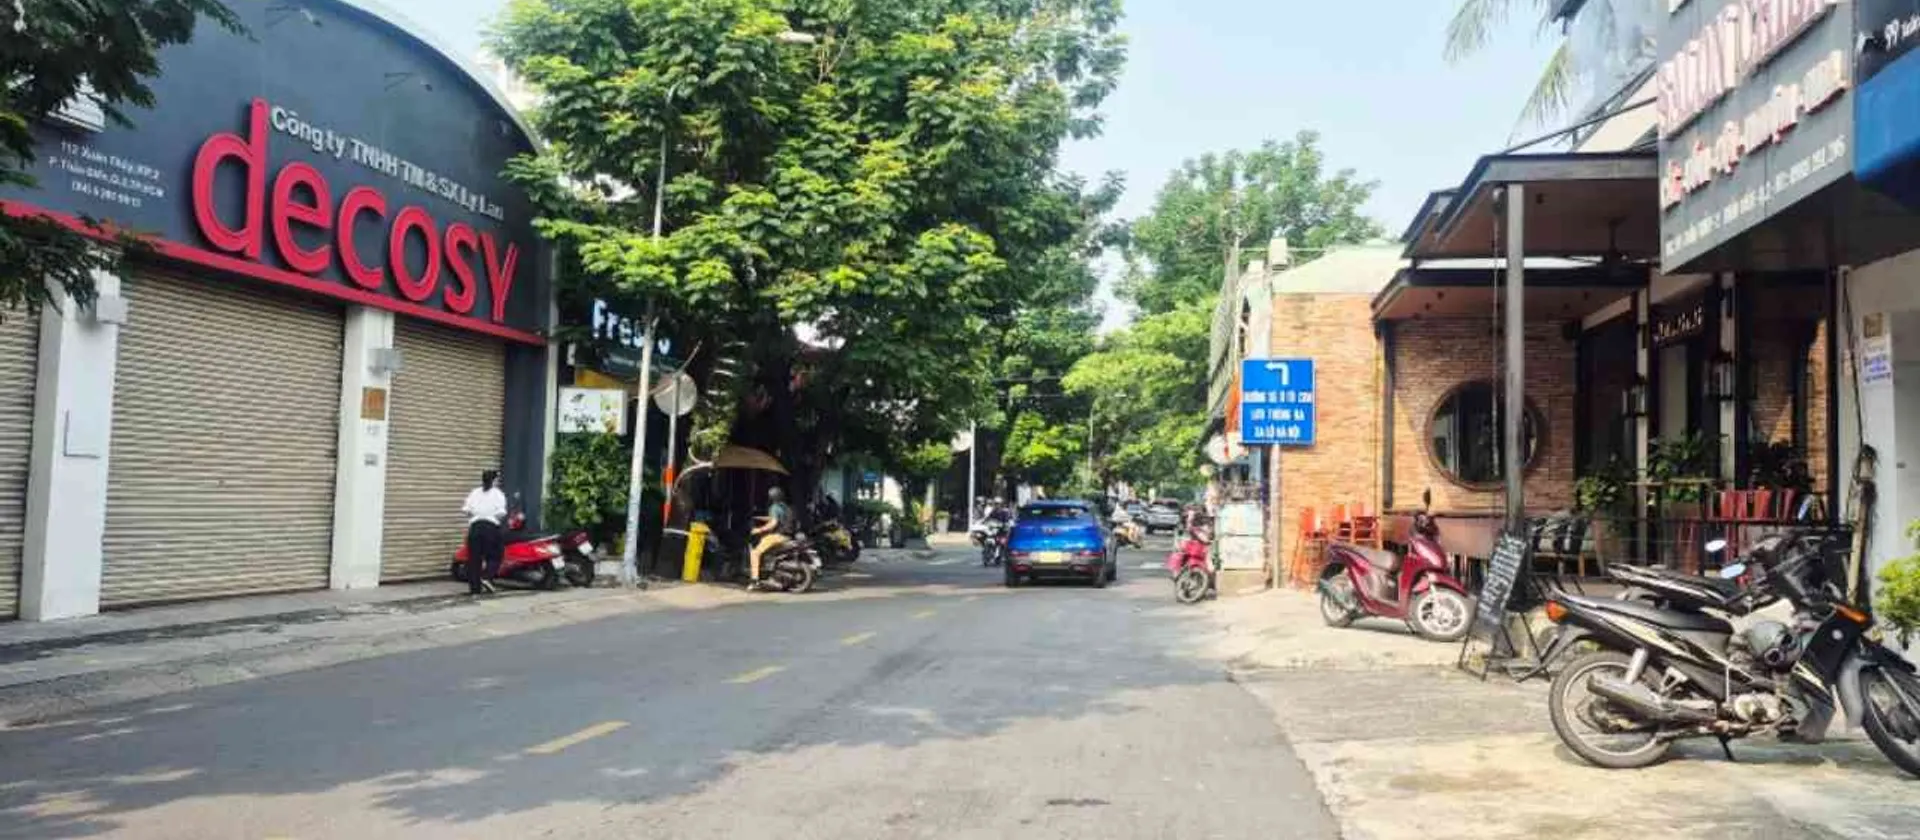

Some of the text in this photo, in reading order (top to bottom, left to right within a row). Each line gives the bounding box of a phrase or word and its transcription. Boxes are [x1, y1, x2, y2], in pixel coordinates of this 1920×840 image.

[193, 97, 518, 322] decosy
[271, 105, 323, 152] Công
[325, 129, 345, 160] ty
[350, 137, 398, 176] TNHH
